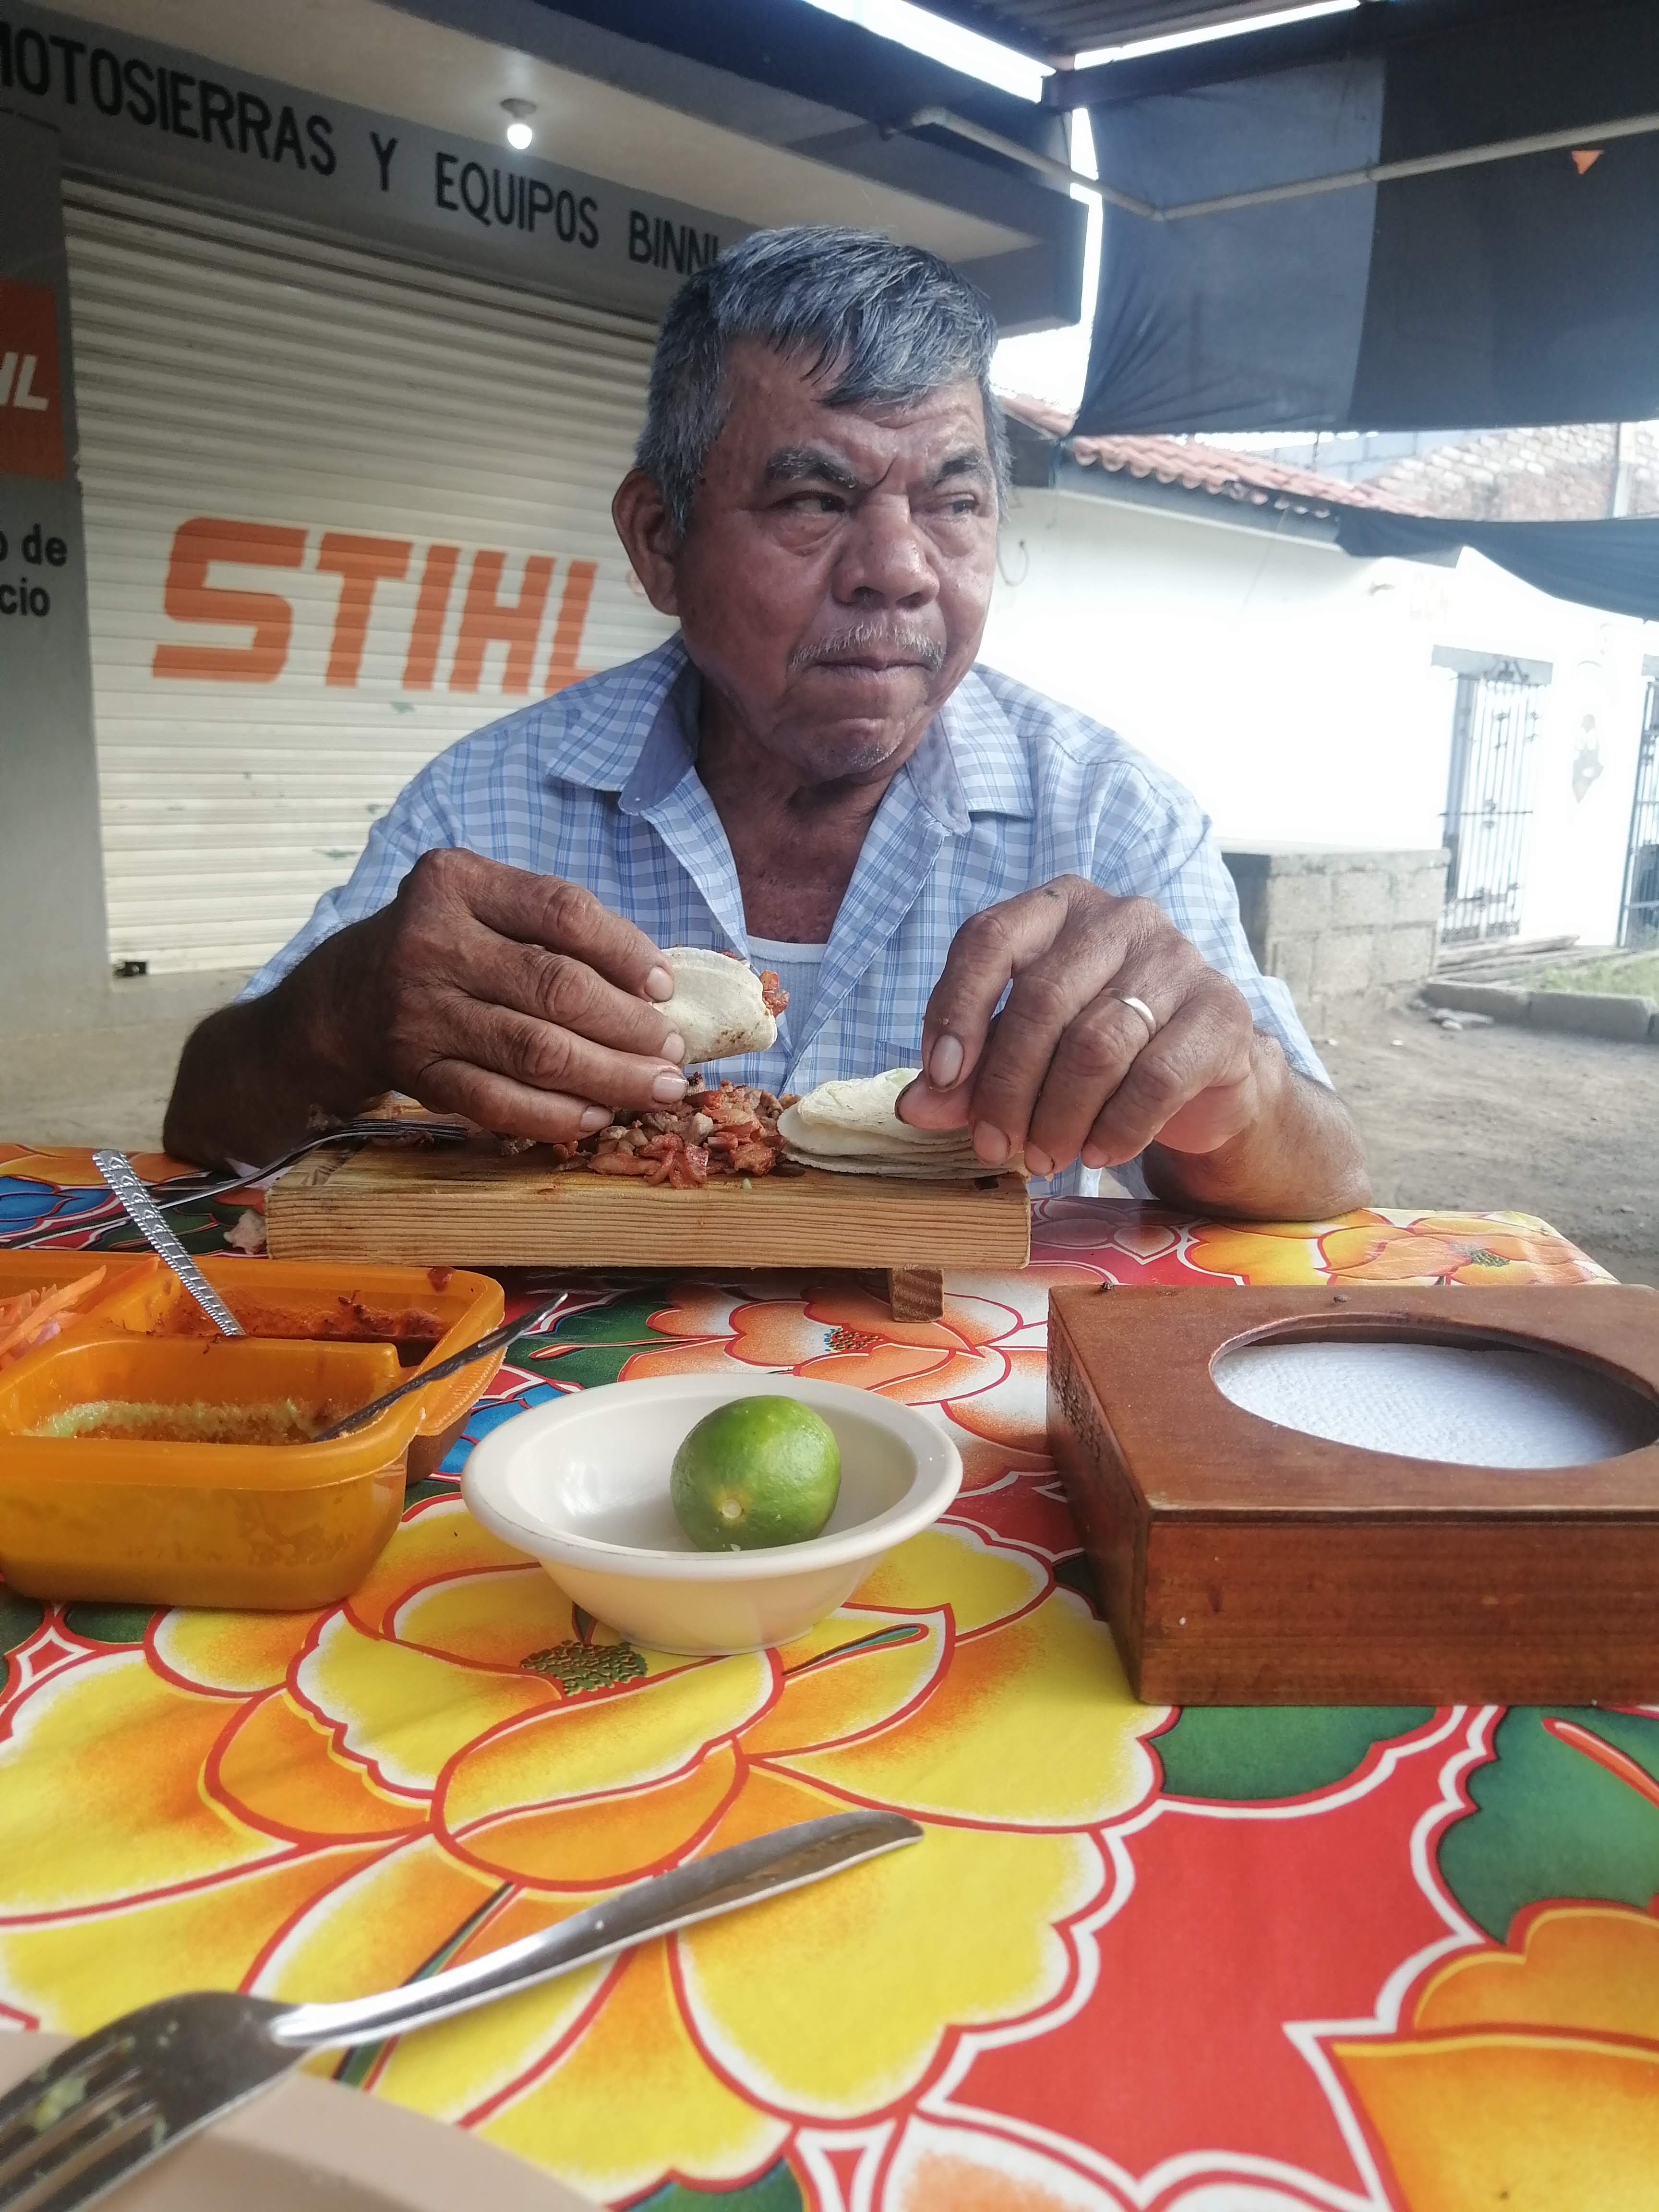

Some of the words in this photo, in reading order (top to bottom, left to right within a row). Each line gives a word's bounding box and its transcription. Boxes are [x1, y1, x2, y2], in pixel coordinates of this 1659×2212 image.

[370, 132, 398, 192] Y
[435, 151, 599, 249] EQUIPOS
[22, 523, 67, 567] de
[152, 517, 604, 696] STIHL
